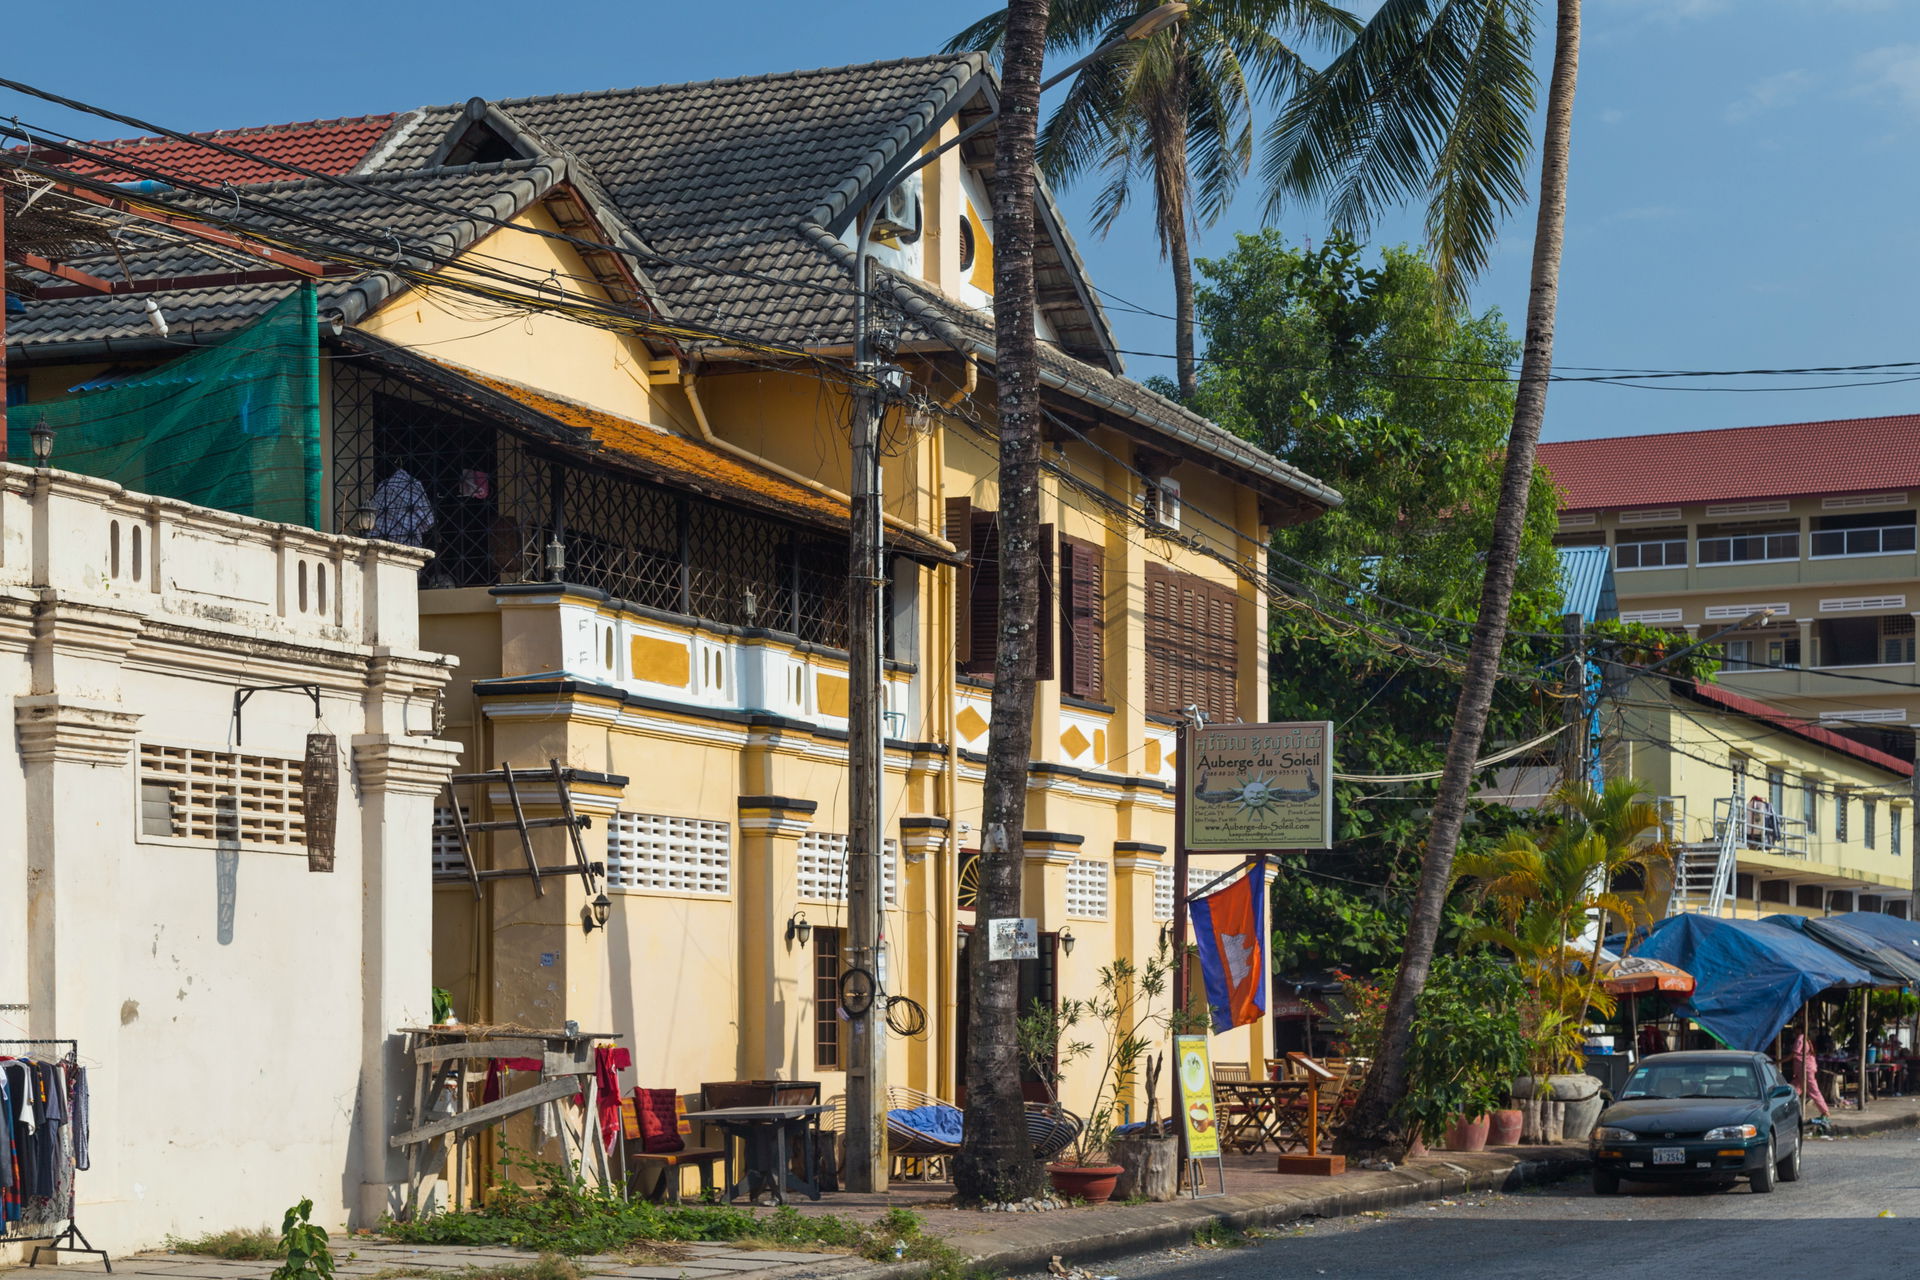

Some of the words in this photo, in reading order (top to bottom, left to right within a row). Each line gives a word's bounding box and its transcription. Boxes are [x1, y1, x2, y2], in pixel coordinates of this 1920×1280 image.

[1197, 755, 1254, 771] Auberge
[1257, 754, 1273, 767] du
[1279, 753, 1320, 768] Soleil
